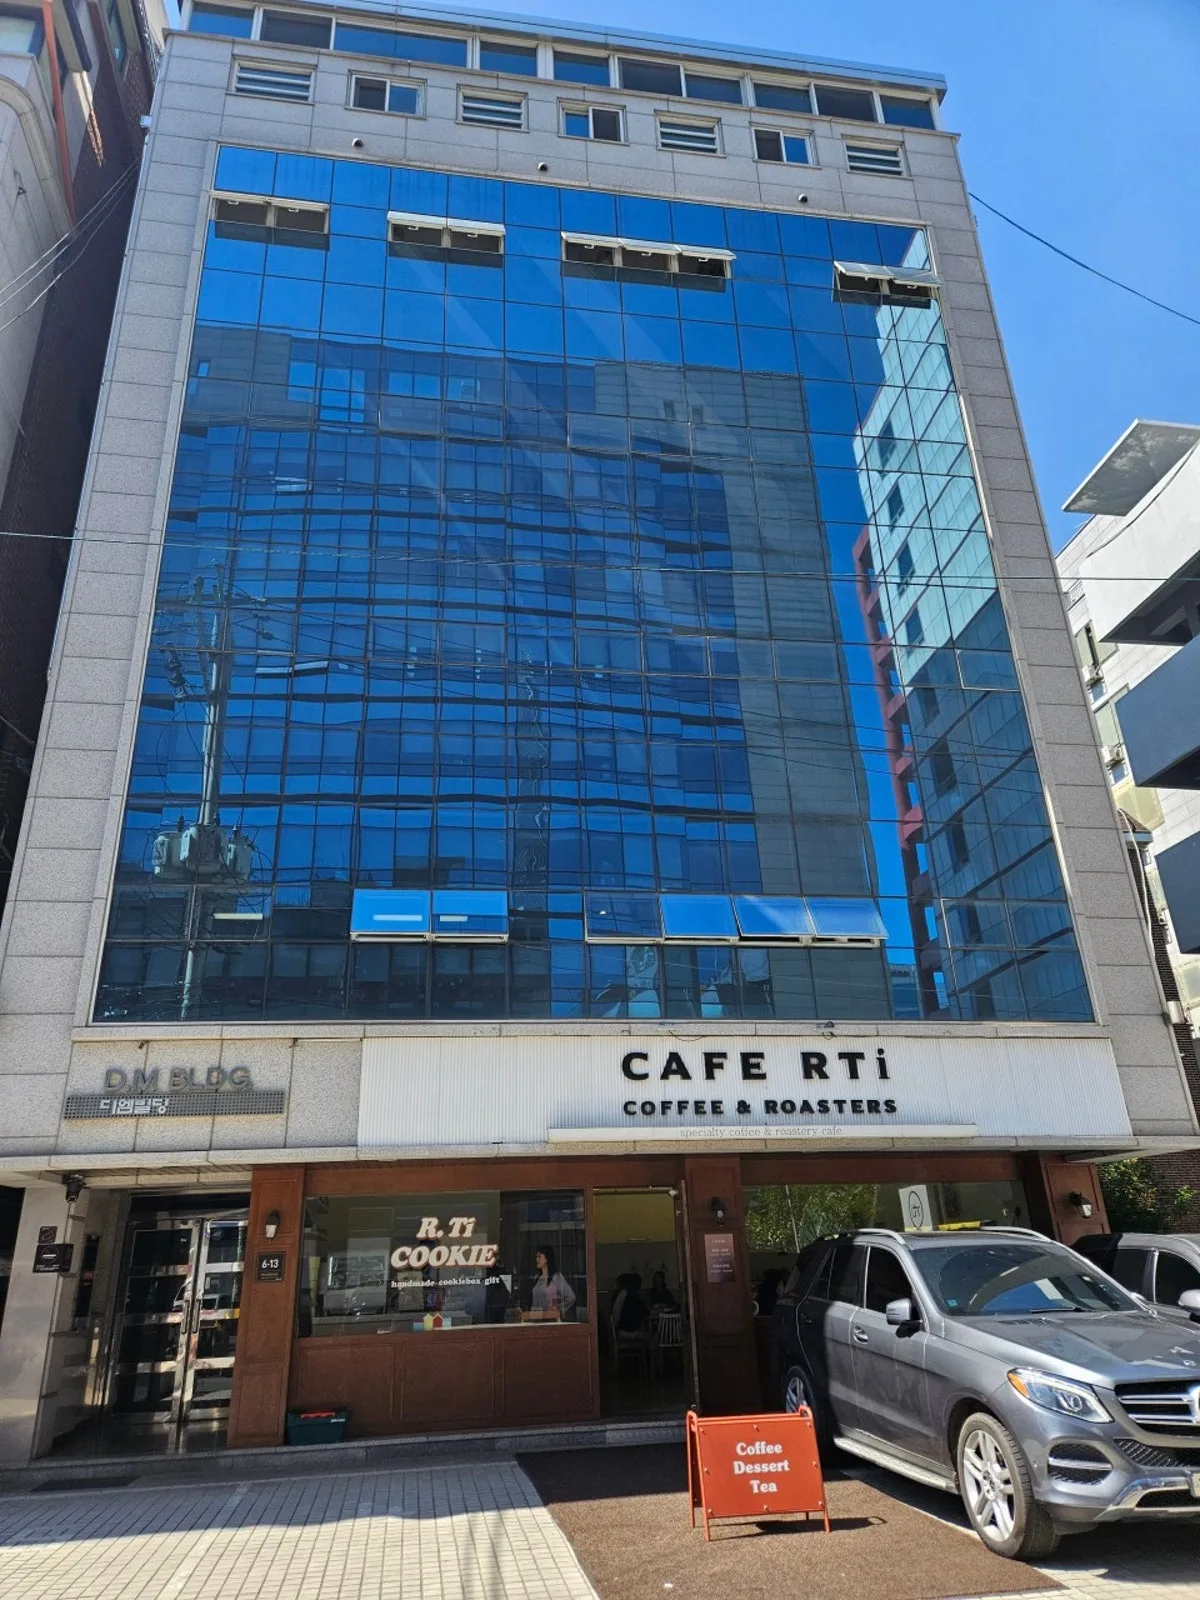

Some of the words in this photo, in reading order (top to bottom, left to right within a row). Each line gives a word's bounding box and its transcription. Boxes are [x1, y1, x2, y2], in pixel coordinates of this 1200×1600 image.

[621, 1051, 767, 1081] CAFE
[801, 1048, 890, 1080] RTi
[104, 1067, 160, 1093] D.M
[169, 1065, 253, 1092] BLDG
[100, 1098, 169, 1115] 디엠빌딩
[623, 1100, 725, 1116] COFFEE
[736, 1100, 751, 1115] &
[764, 1099, 897, 1115] ROASTERS
[679, 1127, 726, 1139] specialty
[729, 1127, 761, 1137] coffee
[764, 1127, 772, 1136] &
[775, 1127, 818, 1138] roastery
[821, 1126, 843, 1136] cafe
[416, 1217, 444, 1239] R.
[448, 1217, 477, 1238] Ti
[261, 1259, 280, 1269] 6-13
[390, 1244, 499, 1269] COOKIE
[391, 1280, 435, 1288] handmade
[438, 1276, 481, 1286] cookiebox
[484, 1276, 500, 1286] gift
[736, 1441, 783, 1456] Coffee
[733, 1460, 790, 1475] Dessert
[750, 1479, 778, 1494] Tea
